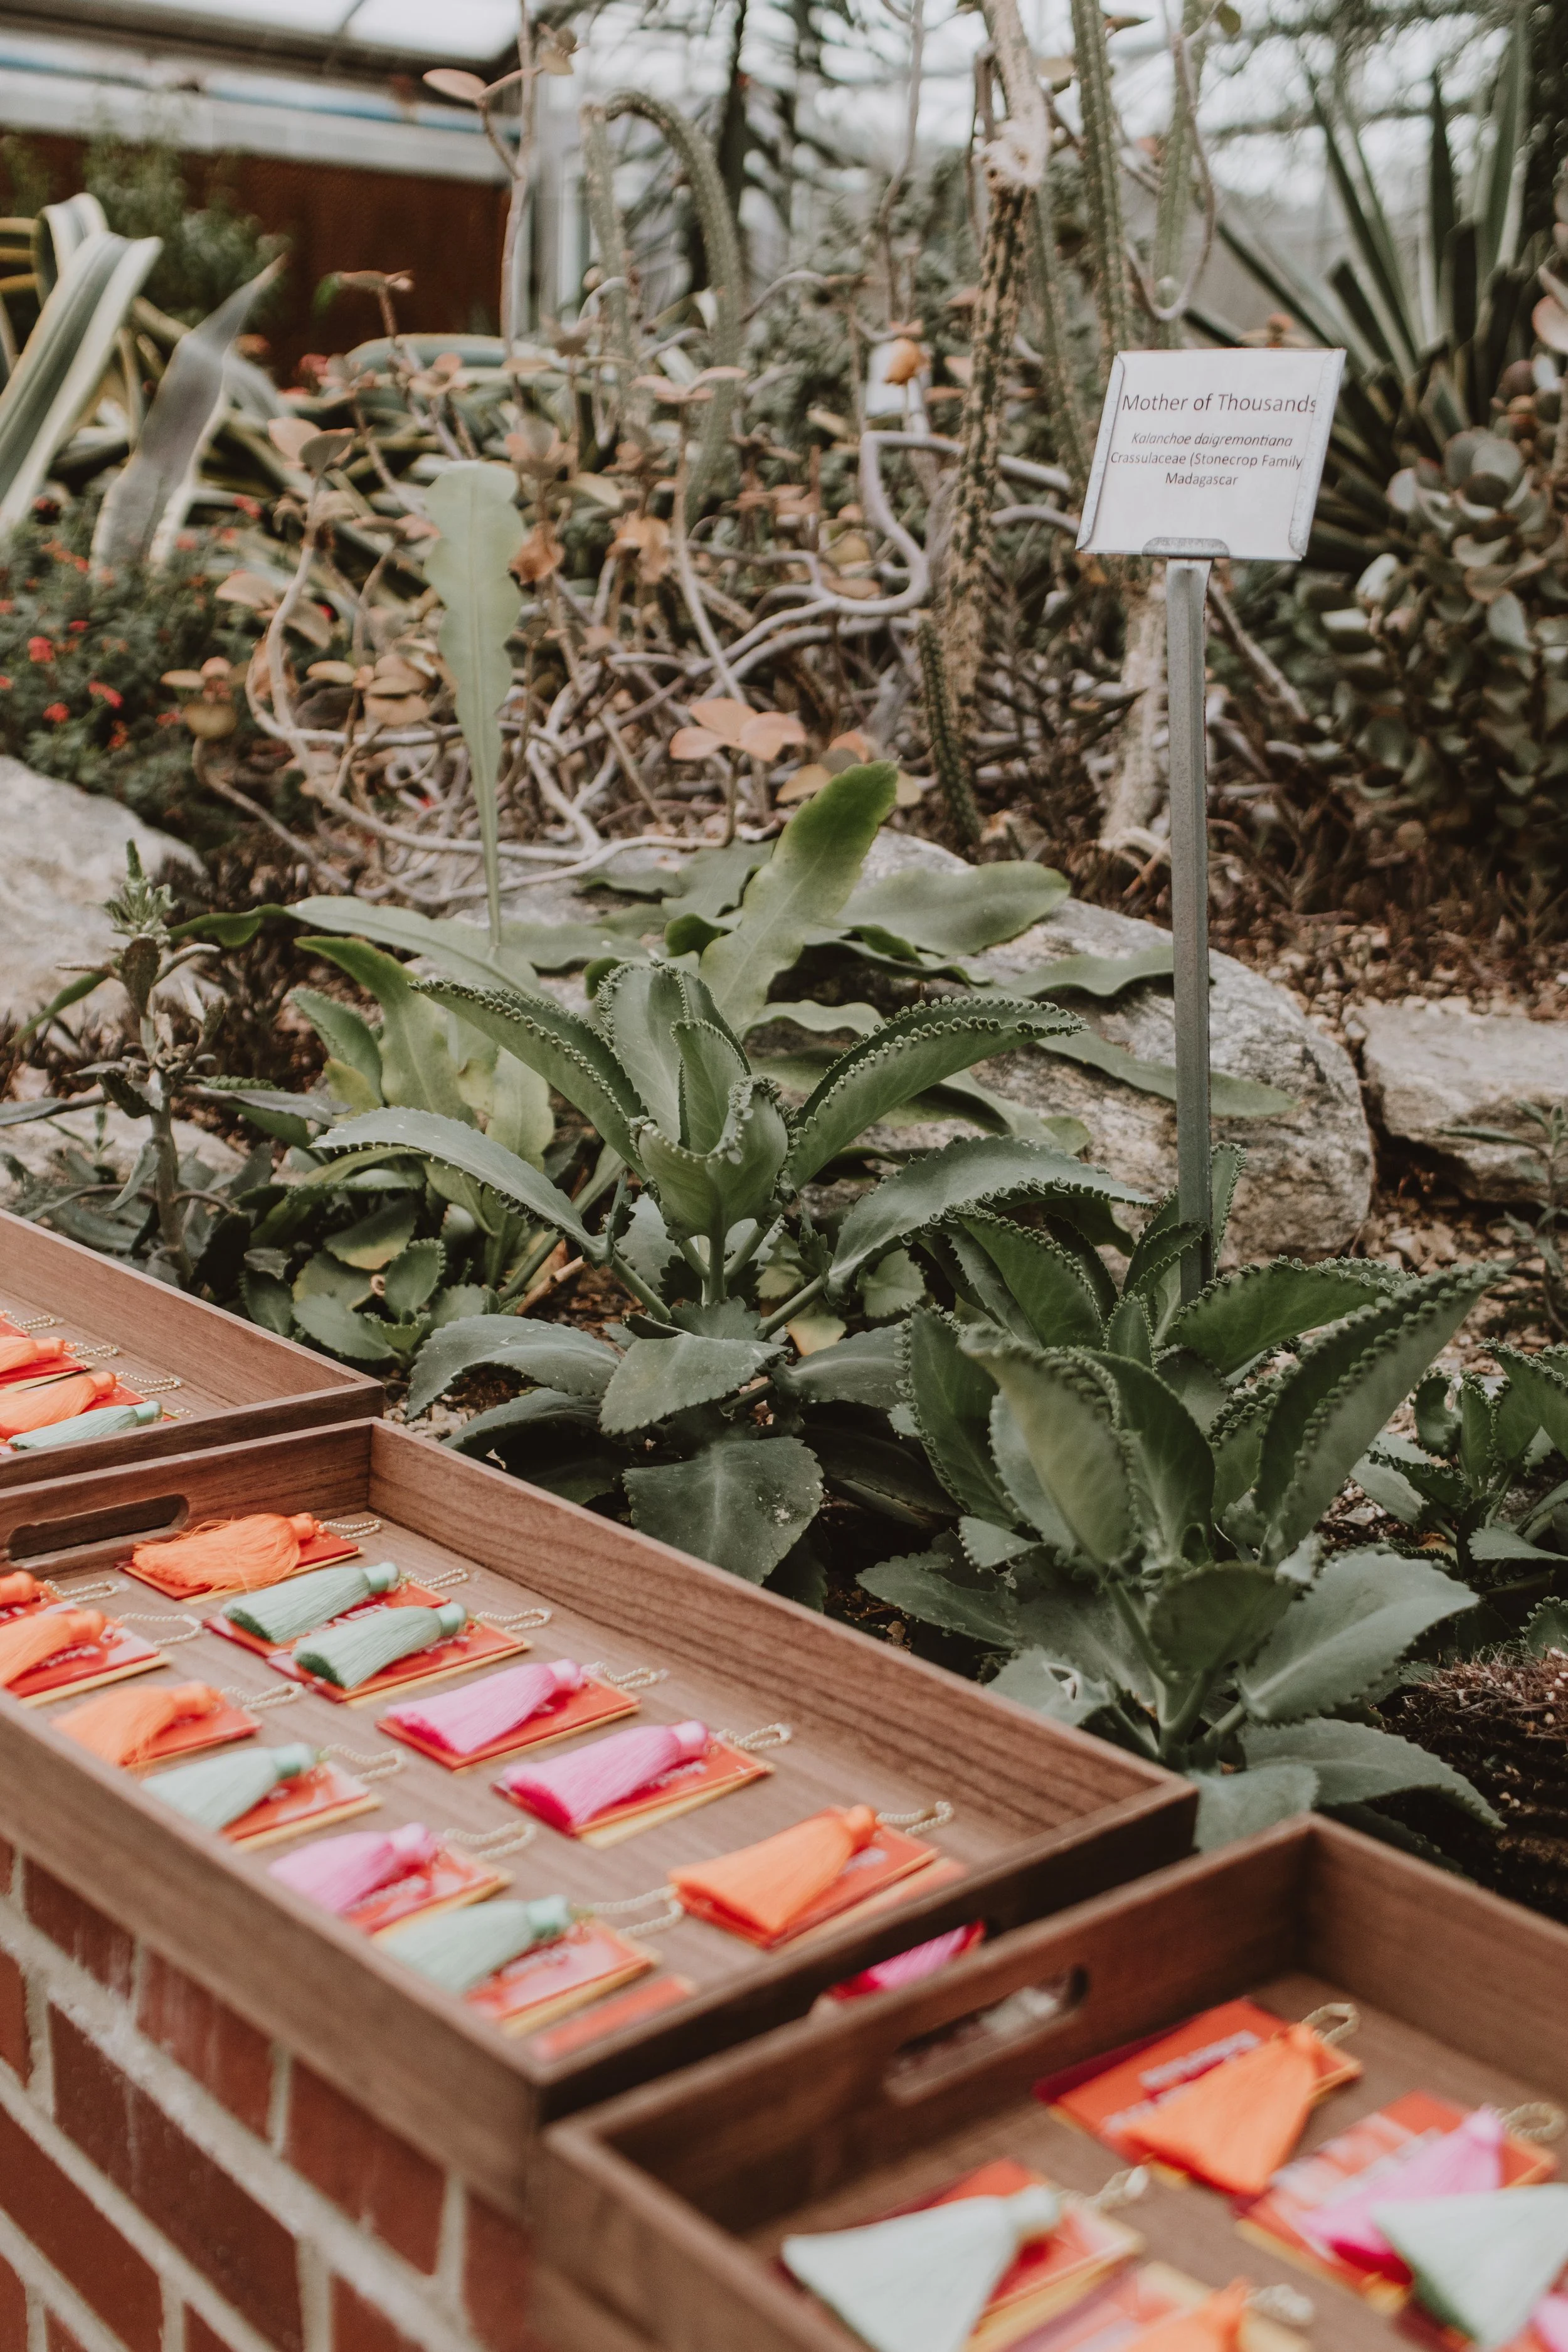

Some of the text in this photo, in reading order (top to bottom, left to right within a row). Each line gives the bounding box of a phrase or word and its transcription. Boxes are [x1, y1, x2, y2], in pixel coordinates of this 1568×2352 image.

[1122, 393, 1316, 413] Mother of Thousands
[1131, 432, 1293, 448] Kalanchoe daigremontiana
[1111, 452, 1303, 470] Crassulaceae (Stonecrop Family
[1165, 472, 1239, 488] Madagascar
